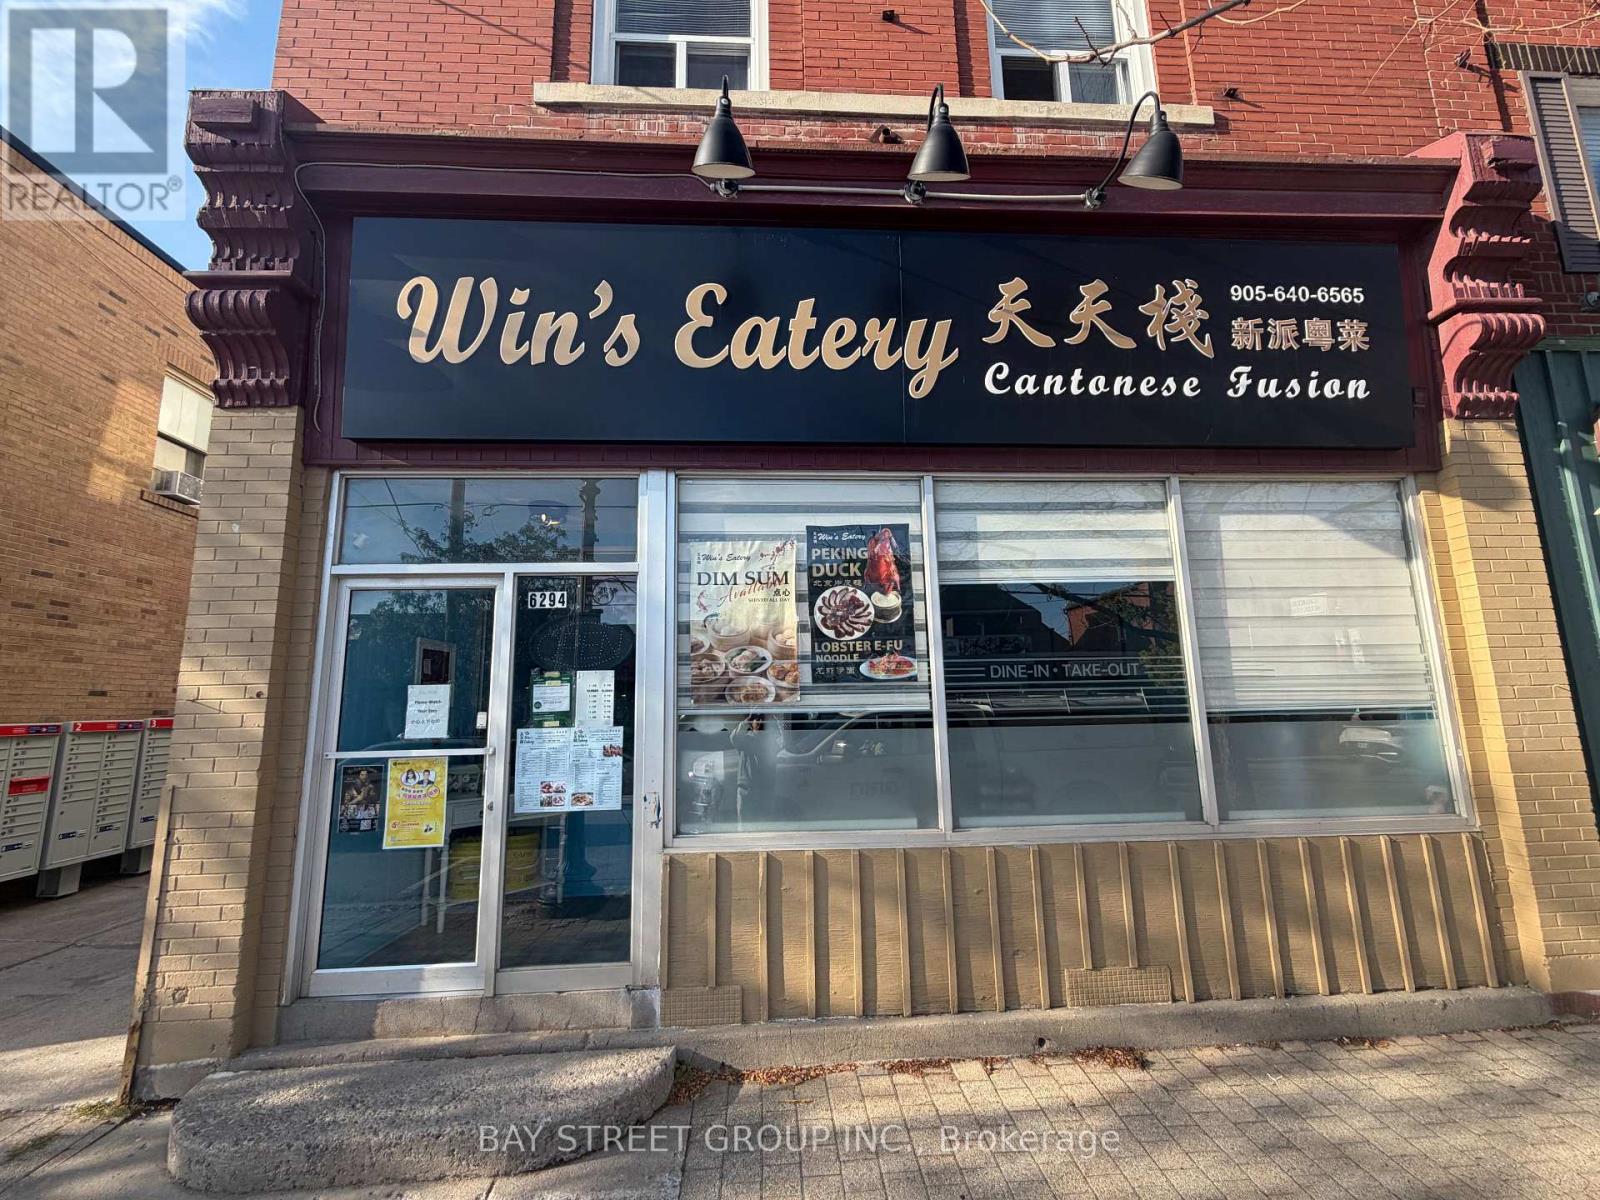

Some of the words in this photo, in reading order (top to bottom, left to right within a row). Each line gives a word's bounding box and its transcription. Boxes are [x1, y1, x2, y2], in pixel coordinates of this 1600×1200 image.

[1230, 285, 1364, 303] 905-640-6565
[982, 277, 1214, 359] 天天棧
[397, 276, 640, 367] Win's
[674, 282, 959, 399] Eatery
[984, 362, 1201, 396] Cantonese
[1226, 365, 1370, 399] Fusion
[811, 547, 869, 560] PEKING
[812, 562, 861, 577] DUCK
[696, 571, 739, 586] DIM
[744, 571, 790, 586] SUM
[529, 592, 566, 608] 6294
[814, 640, 872, 653] LOBSTER
[874, 639, 903, 651] E-FU
[815, 653, 860, 663] NOODLE
[990, 664, 1050, 679] DINE-IN
[1062, 662, 1139, 677] TAKE-OUT
[75, 723, 82, 731] 2
[151, 720, 157, 728] 3
